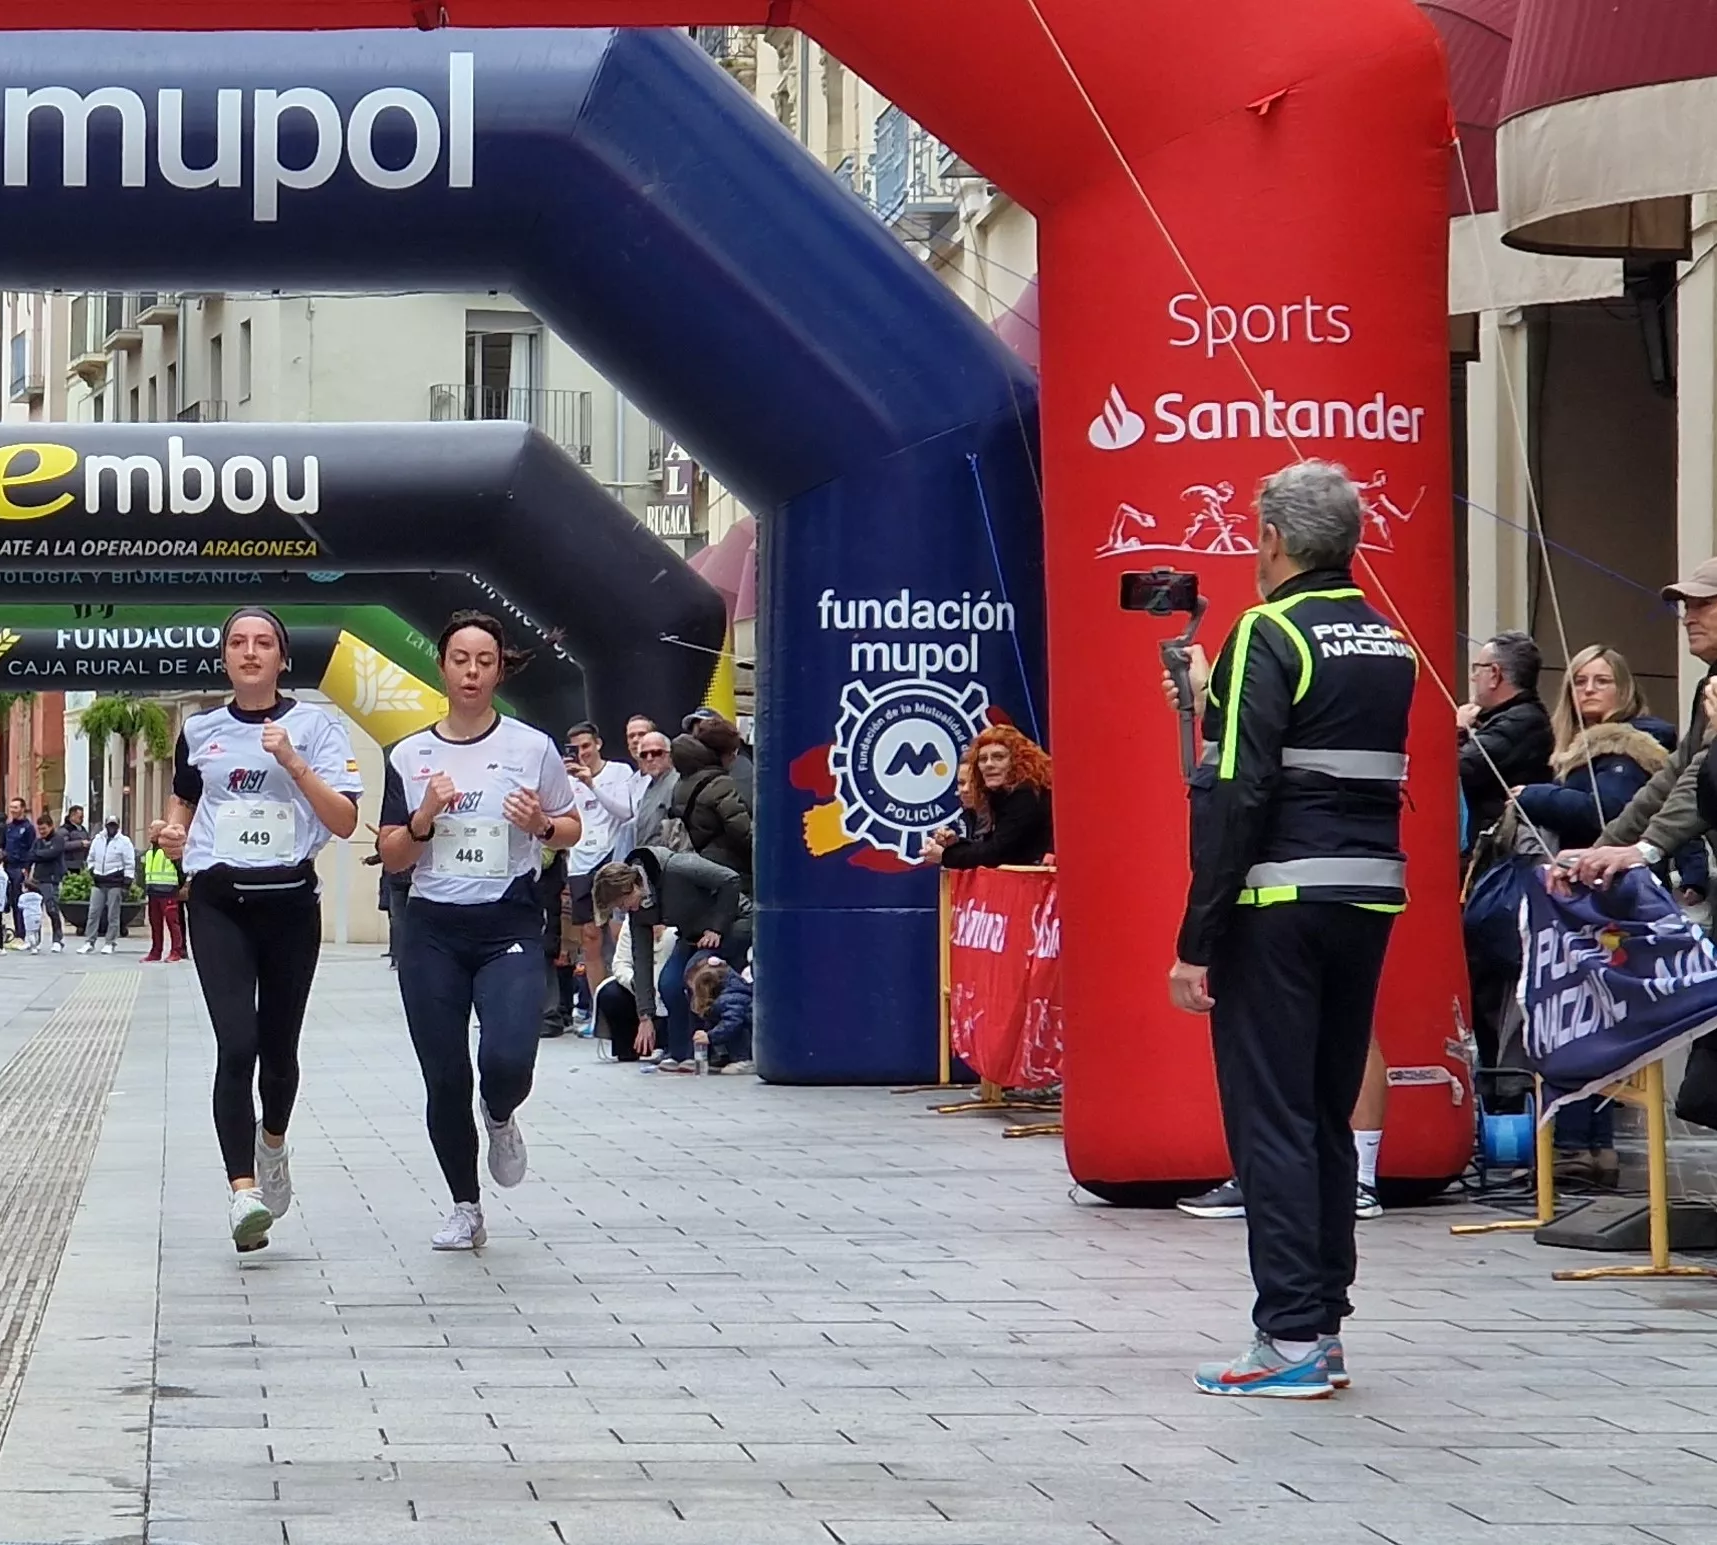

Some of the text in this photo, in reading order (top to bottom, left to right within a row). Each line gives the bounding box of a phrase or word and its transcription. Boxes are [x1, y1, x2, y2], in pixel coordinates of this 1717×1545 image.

[3, 52, 474, 222] mupol
[1168, 293, 1351, 357] Sports
[1154, 389, 1425, 445] Santander
[35, 540, 49, 556] A
[53, 540, 76, 556] LA
[81, 540, 198, 556] OPERADORA
[201, 540, 318, 556] ARAGONESA
[817, 588, 1015, 631] fundación
[56, 627, 222, 649] FUNDACIO
[7, 659, 68, 676] CAJA
[76, 659, 150, 675] RURAL
[159, 659, 188, 674] DE
[850, 633, 979, 680] mupol
[858, 717, 886, 772] Fundación
[884, 706, 900, 720] de
[914, 702, 967, 743] Mutualidad
[884, 802, 946, 823] POLICÍA
[239, 831, 271, 845] 449
[455, 848, 484, 863] 448
